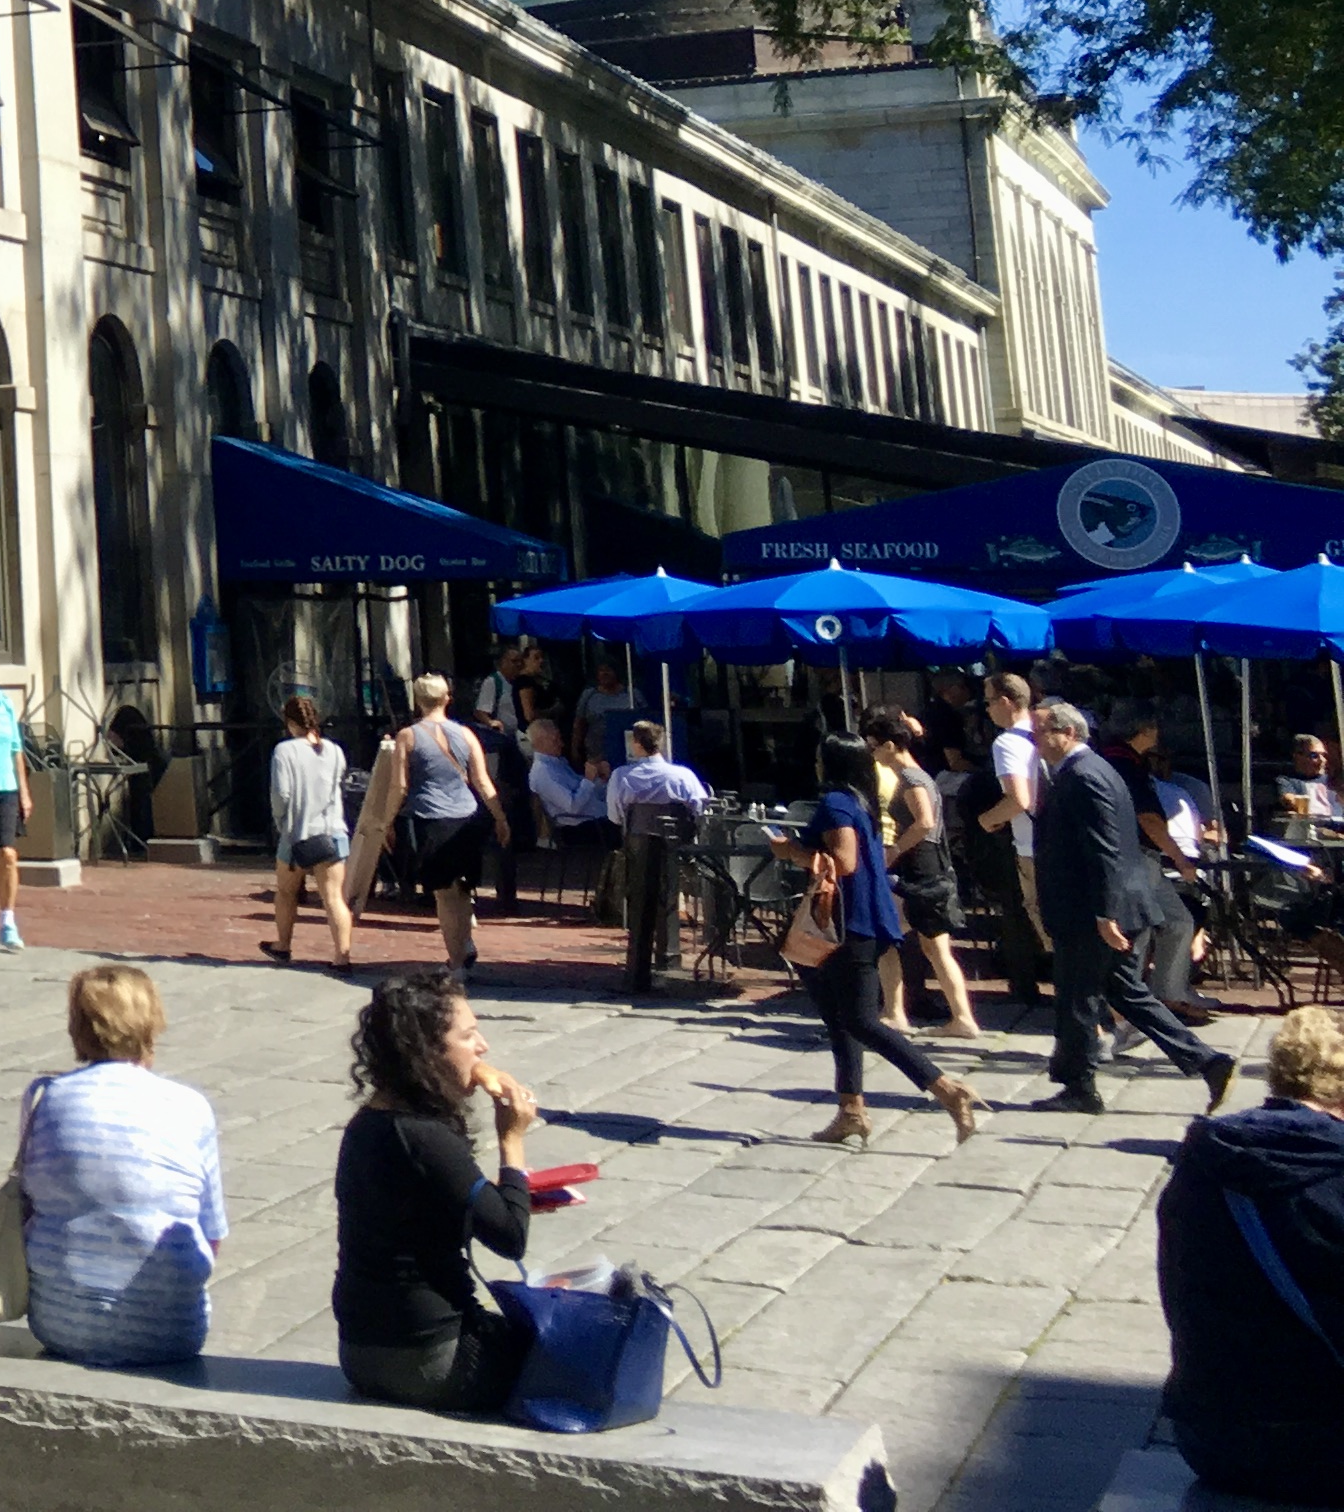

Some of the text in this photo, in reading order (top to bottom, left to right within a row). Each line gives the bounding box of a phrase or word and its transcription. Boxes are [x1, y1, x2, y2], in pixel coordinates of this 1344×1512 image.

[760, 541, 939, 559] FRESH SEAFOOD
[310, 554, 426, 572] SALTY DOG
